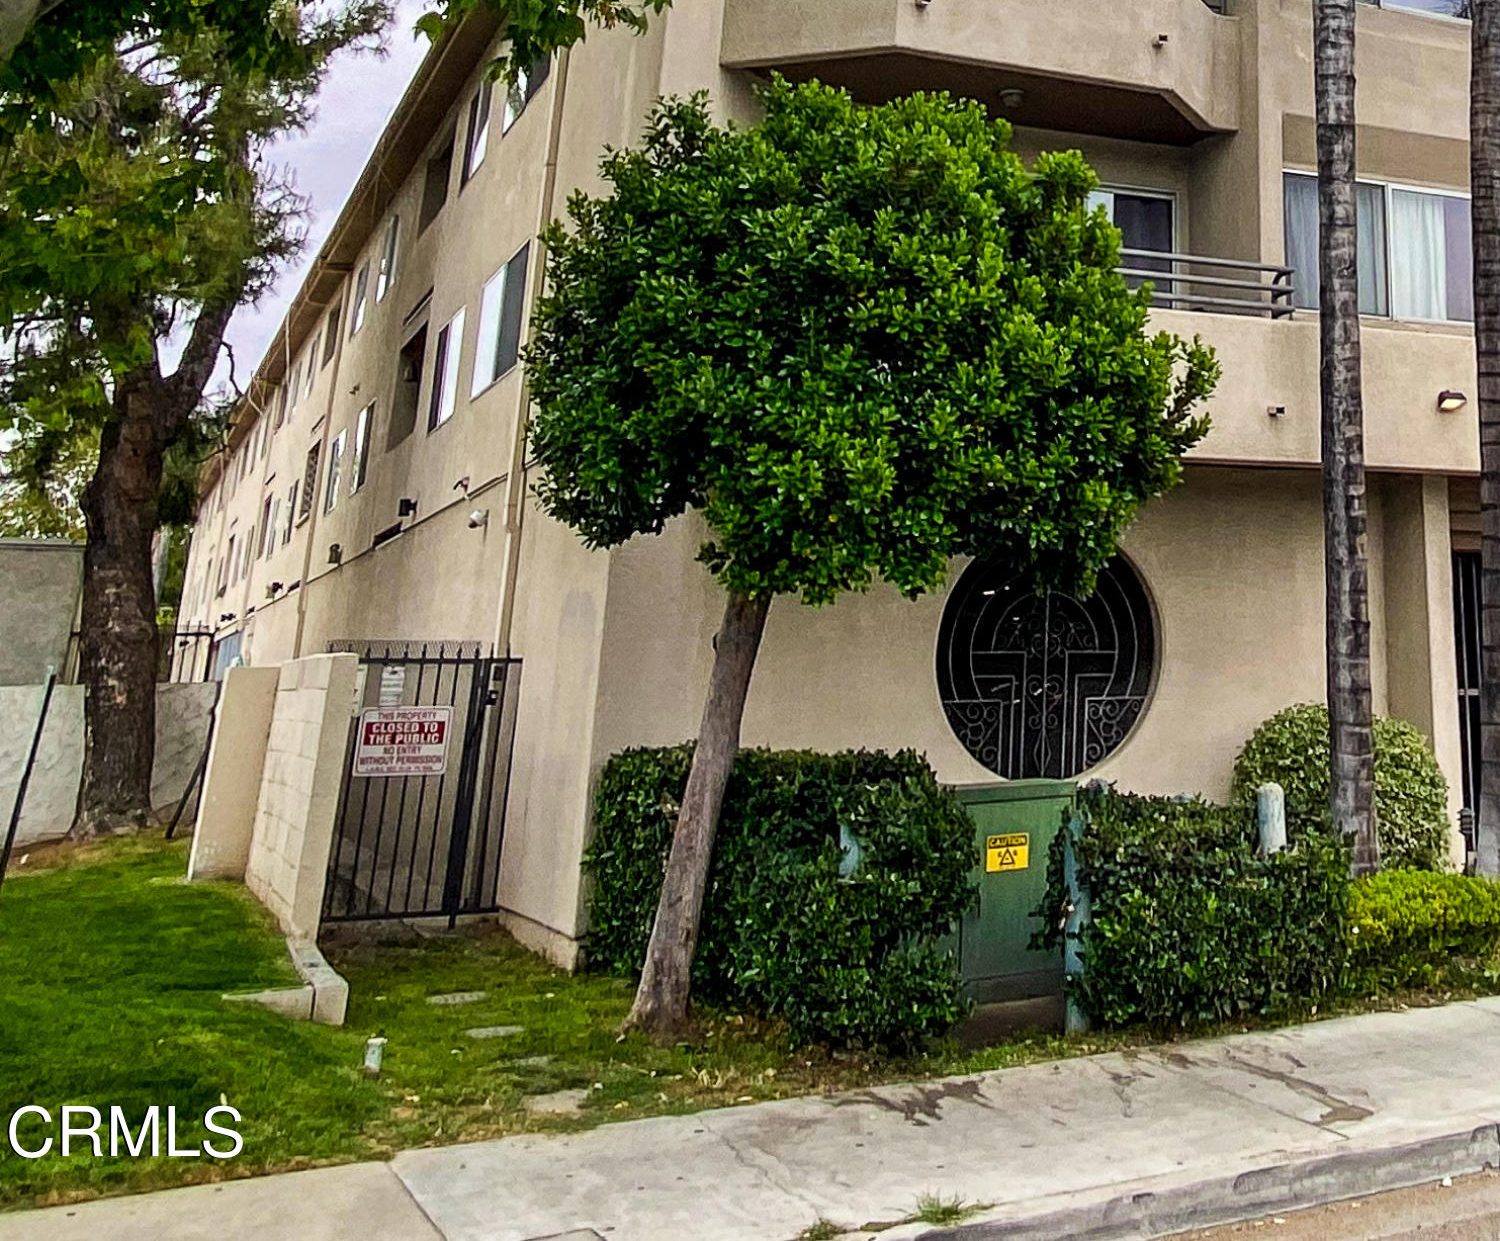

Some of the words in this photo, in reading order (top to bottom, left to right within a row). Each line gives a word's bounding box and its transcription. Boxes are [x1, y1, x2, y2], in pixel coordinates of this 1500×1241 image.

[397, 711, 436, 720] PROPERTY
[372, 722, 420, 733] CLOSED
[424, 722, 439, 733] TO
[368, 734, 393, 745] THE
[395, 733, 440, 745] PUBLIC
[383, 746, 395, 755] NO
[397, 746, 422, 755] ENTRY
[990, 837, 1026, 847] CAUTION
